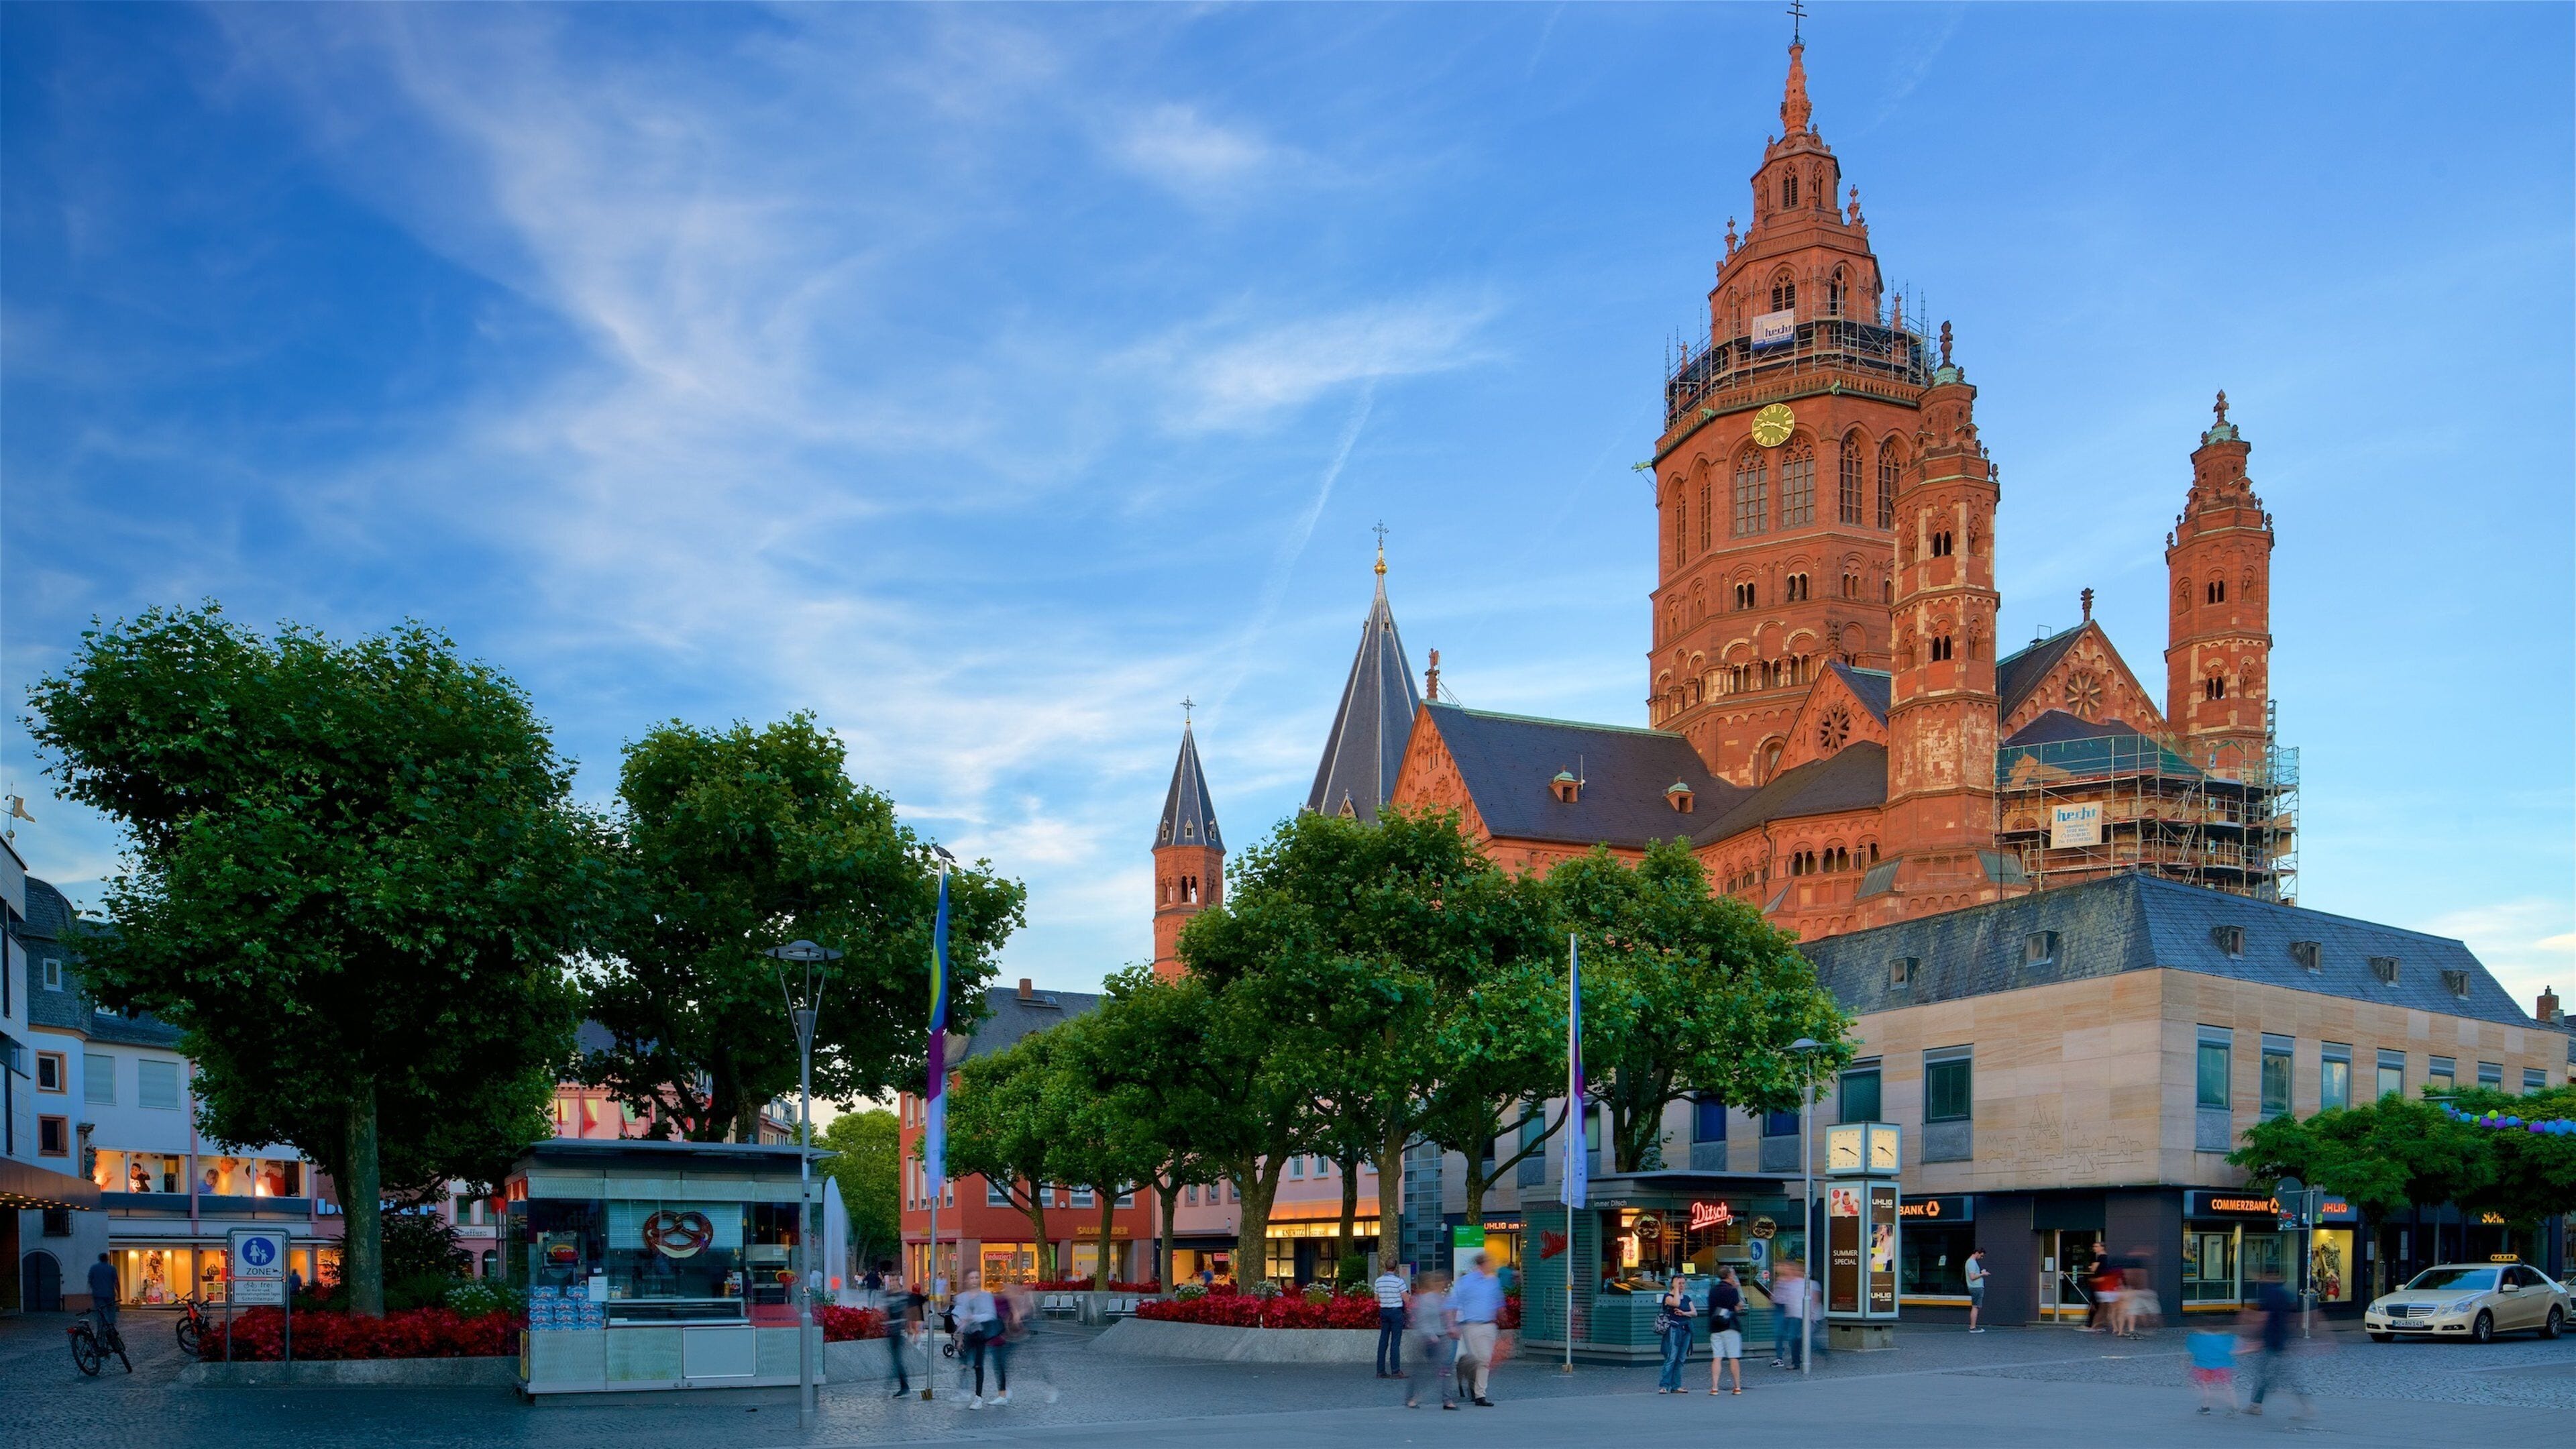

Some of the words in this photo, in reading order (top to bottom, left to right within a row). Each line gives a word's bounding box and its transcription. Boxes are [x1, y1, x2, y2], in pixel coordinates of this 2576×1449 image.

[2211, 1199, 2269, 1212] COMMERZBANK
[1690, 1201, 1729, 1228] Ditsch
[1483, 1222, 1507, 1230] UHLIG
[1834, 1258, 1857, 1266] SPECIAL
